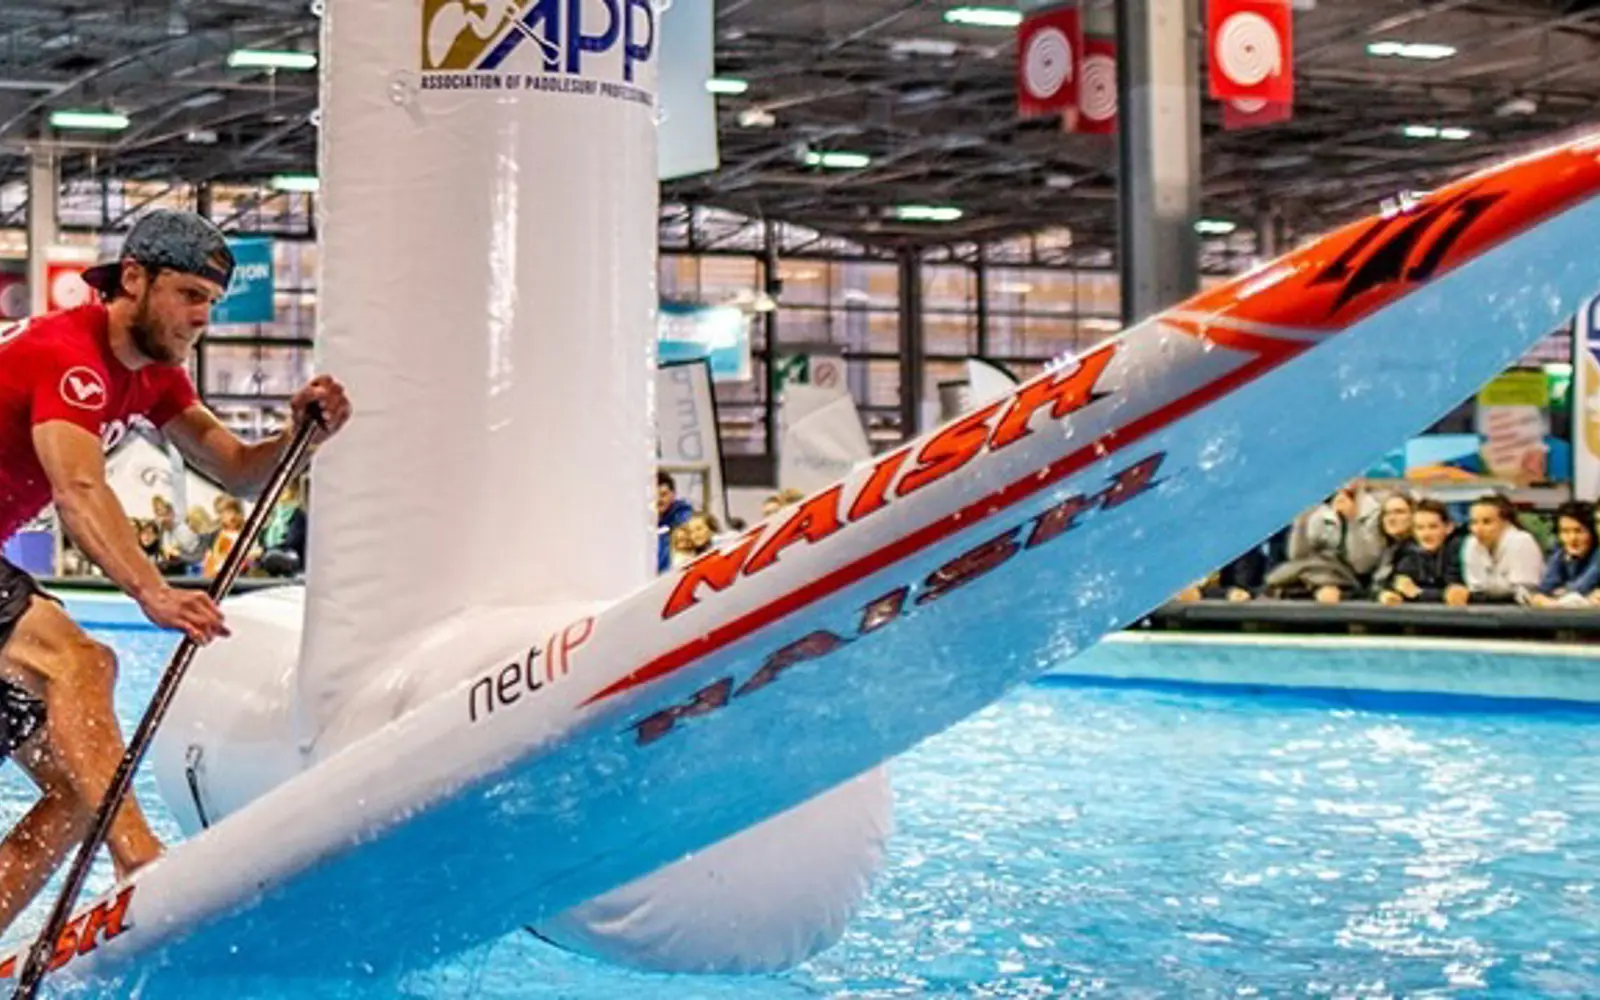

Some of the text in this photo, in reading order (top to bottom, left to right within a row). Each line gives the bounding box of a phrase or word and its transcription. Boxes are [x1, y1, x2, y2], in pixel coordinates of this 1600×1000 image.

[420, 74, 501, 90] ASSOCIATION
[505, 75, 521, 90] OF
[661, 344, 1118, 619] NAISH
[468, 616, 594, 722] netIP
